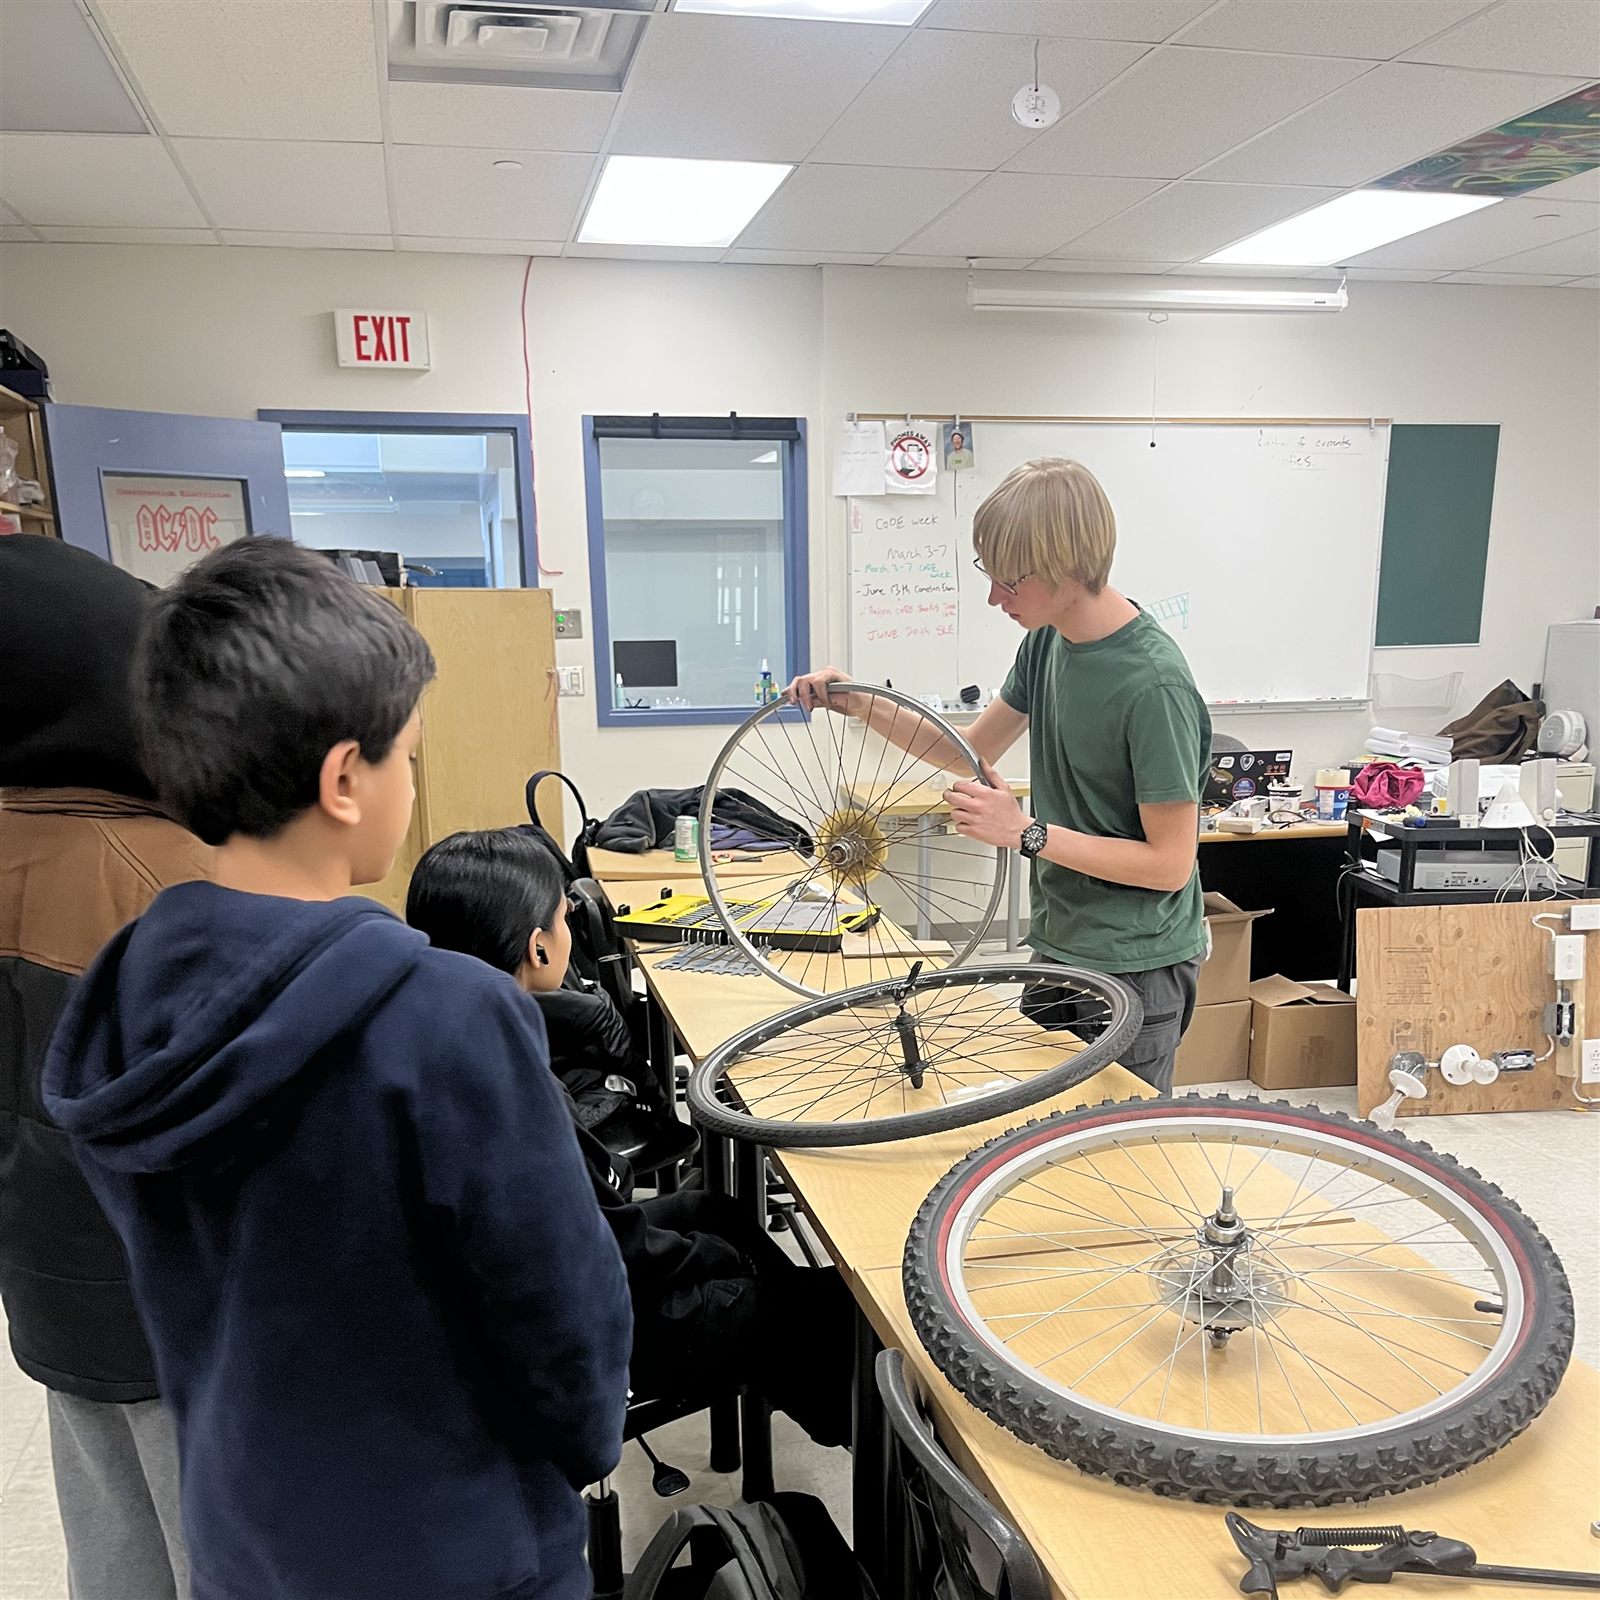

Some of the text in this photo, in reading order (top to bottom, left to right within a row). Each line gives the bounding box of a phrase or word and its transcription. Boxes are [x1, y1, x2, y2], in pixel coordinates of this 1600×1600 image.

[353, 315, 411, 362] EXIT
[890, 430, 914, 447] PHONES
[914, 432, 932, 447] AWAY
[911, 514, 938, 526] week
[887, 544, 948, 560] March 3-7
[864, 563, 888, 574] March
[891, 562, 912, 573] 3-7
[866, 628, 898, 641] JUNE
